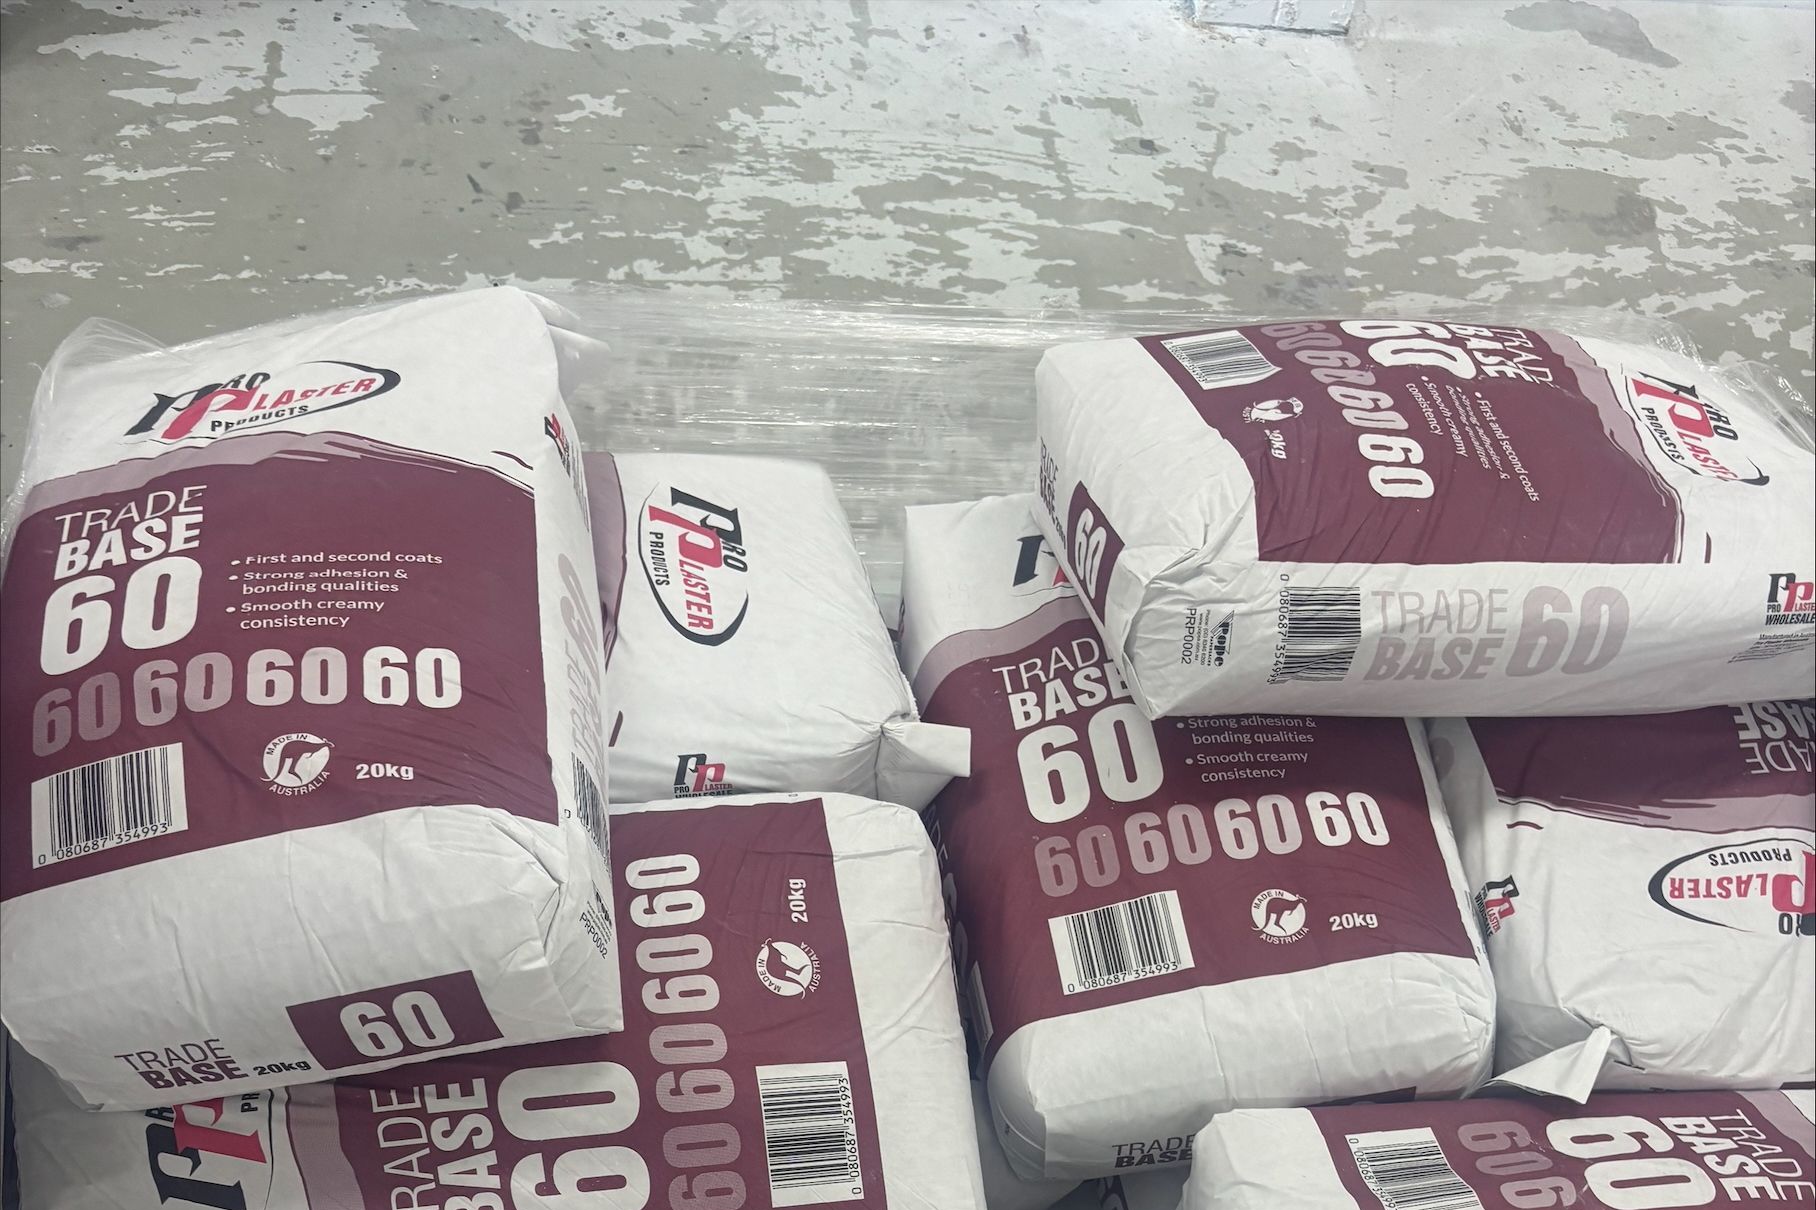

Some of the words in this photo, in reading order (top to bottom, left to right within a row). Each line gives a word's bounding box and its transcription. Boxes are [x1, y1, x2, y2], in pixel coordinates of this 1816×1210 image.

[1339, 320, 1477, 380] 60
[210, 405, 309, 433] PRODUCTS
[1326, 385, 1410, 431] 60
[1405, 383, 1444, 436] consistency
[1358, 433, 1435, 499] 60
[1500, 439, 1524, 475] second
[1519, 472, 1541, 502] coats
[55, 485, 208, 543] TRADE
[53, 514, 204, 580] BASE
[246, 554, 287, 565] First
[291, 552, 324, 563] and
[328, 551, 391, 563] second
[395, 554, 443, 565] coats
[648, 531, 671, 587] PRODUCTS
[648, 504, 724, 630] PLASTER
[1075, 508, 1107, 600] 60
[243, 572, 304, 581] Strong
[309, 569, 390, 578] adhesion
[394, 569, 408, 579] &
[243, 581, 316, 595] bonding
[321, 581, 399, 593] qualities
[40, 556, 203, 676] 60
[240, 615, 350, 629] consistency
[241, 599, 312, 613] Smooth
[317, 600, 385, 611] creamy
[1371, 588, 1509, 635] TRADE
[1181, 607, 1197, 665] PRP0002
[1505, 585, 1630, 678] 60
[1363, 637, 1504, 682] BASE
[31, 671, 122, 757] 60
[133, 652, 234, 727] 60
[246, 646, 347, 706] 60
[362, 645, 462, 709] 60
[1240, 716, 1302, 728] adhesion
[266, 735, 293, 756] MADE
[1192, 731, 1251, 746] bonding
[1254, 730, 1314, 745] qualities
[1197, 751, 1254, 765] Smooth
[1256, 750, 1308, 766] creamy
[268, 769, 331, 797] AUSTRALIA
[355, 763, 414, 780] 20kg
[1017, 703, 1165, 824] 60
[1200, 766, 1286, 783] consistency
[56, 837, 109, 861] 080687
[115, 822, 169, 846] 354993
[1033, 824, 1121, 897] 60
[1124, 803, 1213, 874] 60
[1213, 794, 1303, 860] 60
[1305, 791, 1390, 846] 60
[1708, 848, 1793, 866] PRODUCTS
[624, 853, 706, 928] 60
[787, 878, 809, 923] 20kg
[579, 912, 609, 959] PRP0002
[1259, 926, 1310, 944] AUSTRALIA
[1329, 911, 1379, 931] 20kg
[635, 933, 721, 1015] 60
[800, 941, 821, 993] AUSTRALIA
[1083, 972, 1128, 991] 080687
[1133, 961, 1179, 980] 354993
[339, 990, 455, 1057] 60
[114, 1038, 232, 1073] TRADE
[138, 1059, 249, 1090] BASE
[253, 1059, 311, 1076] 20kg
[648, 1022, 736, 1114] 60
[838, 1077, 855, 1125] 354993
[846, 1130, 860, 1181] 080687
[1112, 1134, 1197, 1156] TRADE
[1115, 1149, 1194, 1169] BASE
[1354, 1151, 1378, 1185] 080687
[1456, 1120, 1554, 1177] 60
[1545, 1115, 1717, 1210] 60
[1658, 1116, 1784, 1202] BASE
[1709, 1108, 1815, 1201] TRADE
